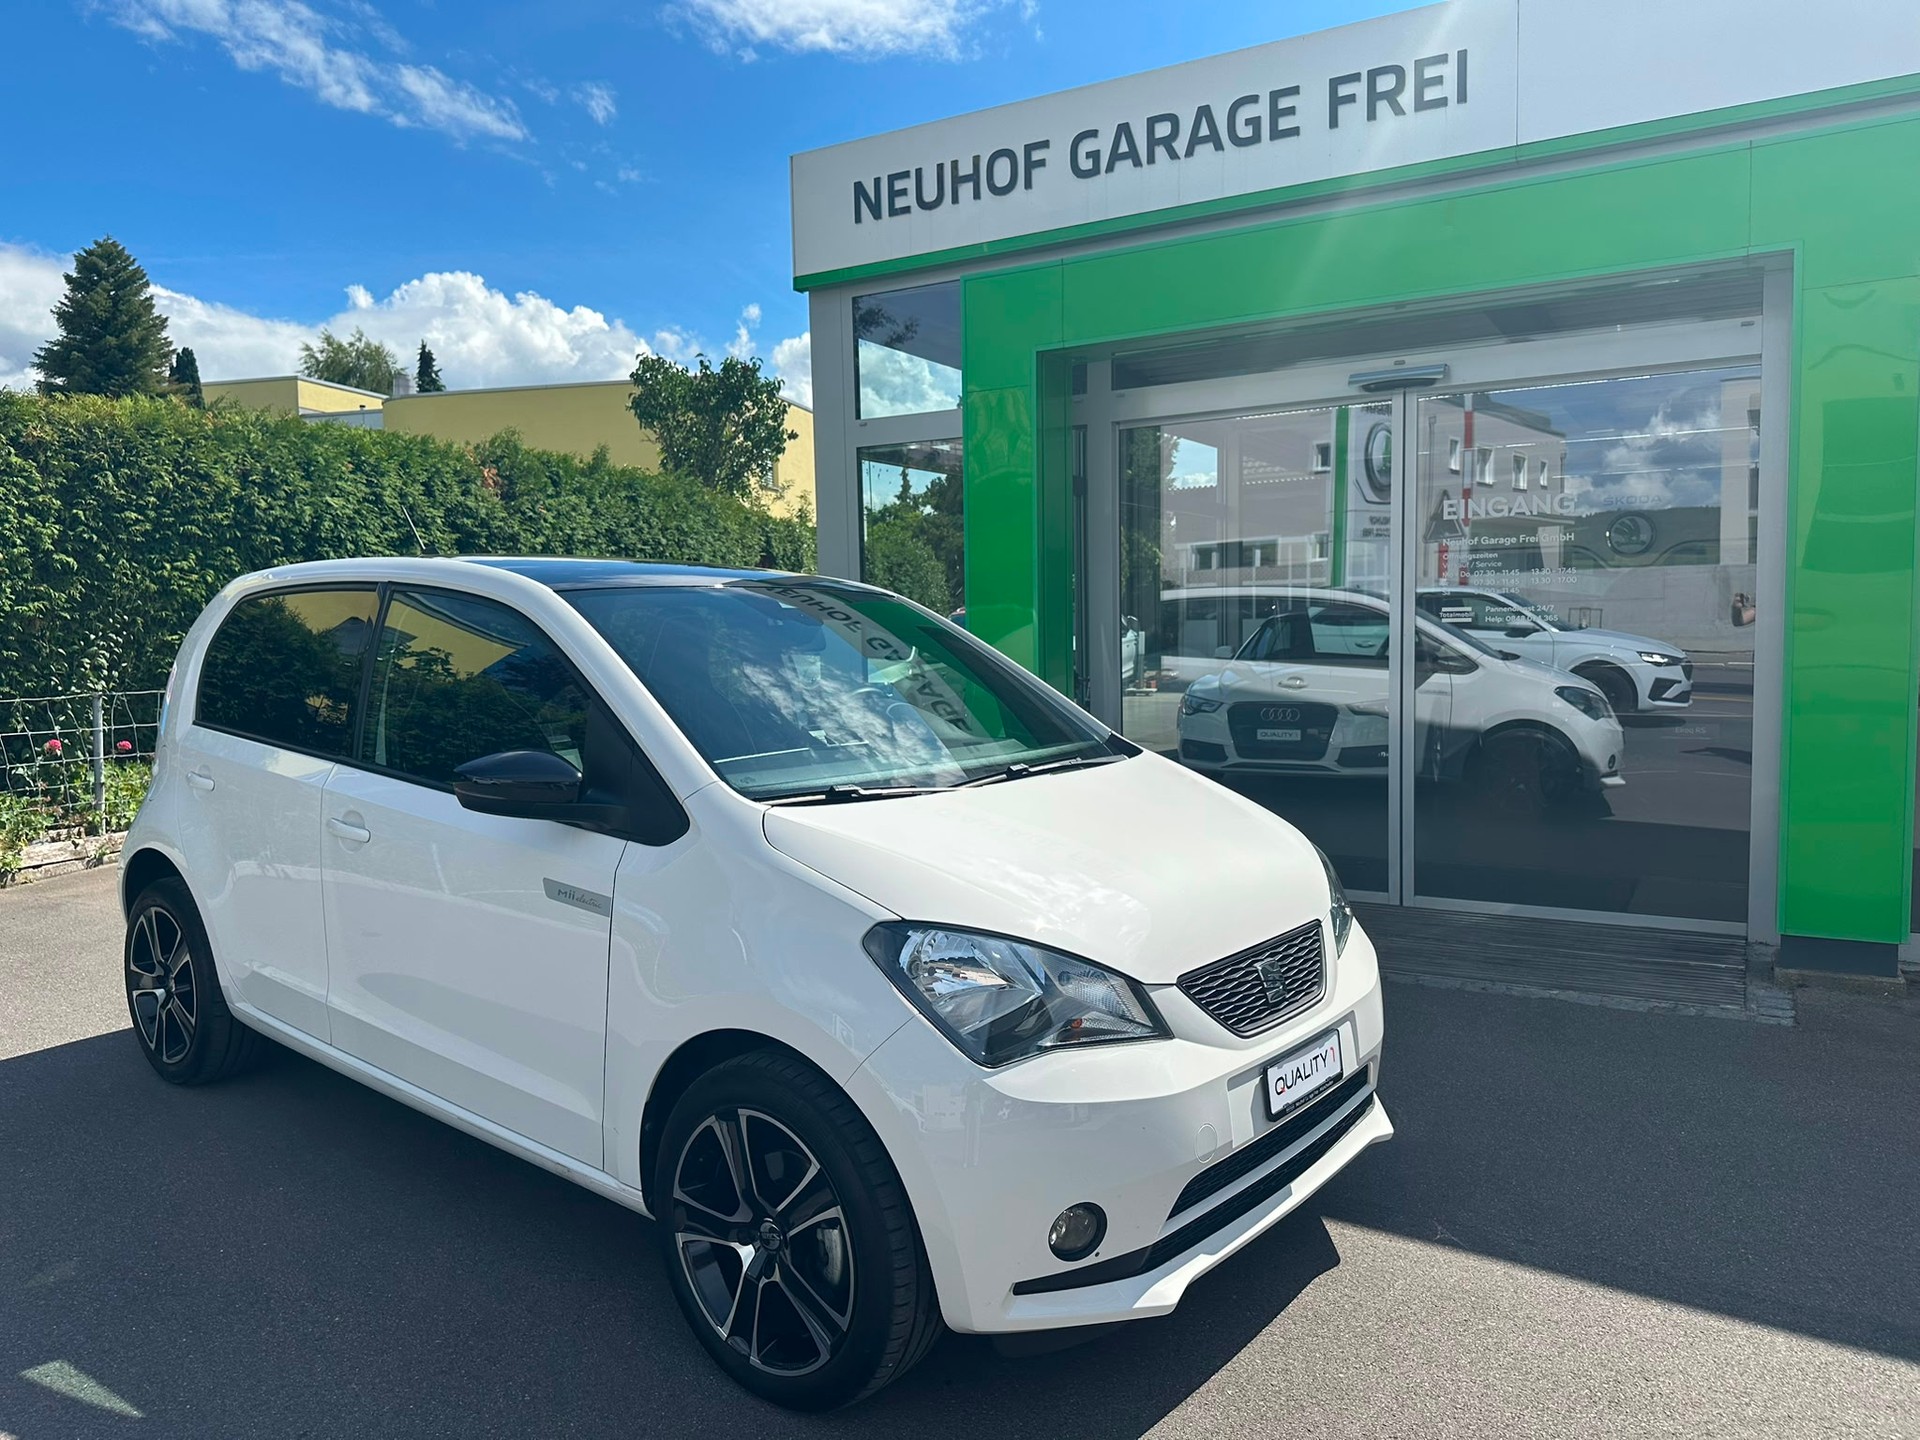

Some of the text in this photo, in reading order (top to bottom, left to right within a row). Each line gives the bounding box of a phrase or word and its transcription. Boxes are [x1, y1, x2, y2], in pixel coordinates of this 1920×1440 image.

[853, 48, 1468, 225] NEUHOF GARAGE FREI
[1443, 493, 1575, 520] EINGANG
[1442, 532, 1575, 546] Neuhof Garage Frei GmbH
[1476, 560, 1502, 568] Service
[1485, 604, 1555, 613] Pannendnst 24/7
[558, 889, 575, 900] Mii
[1275, 1049, 1328, 1096] QUALITY
